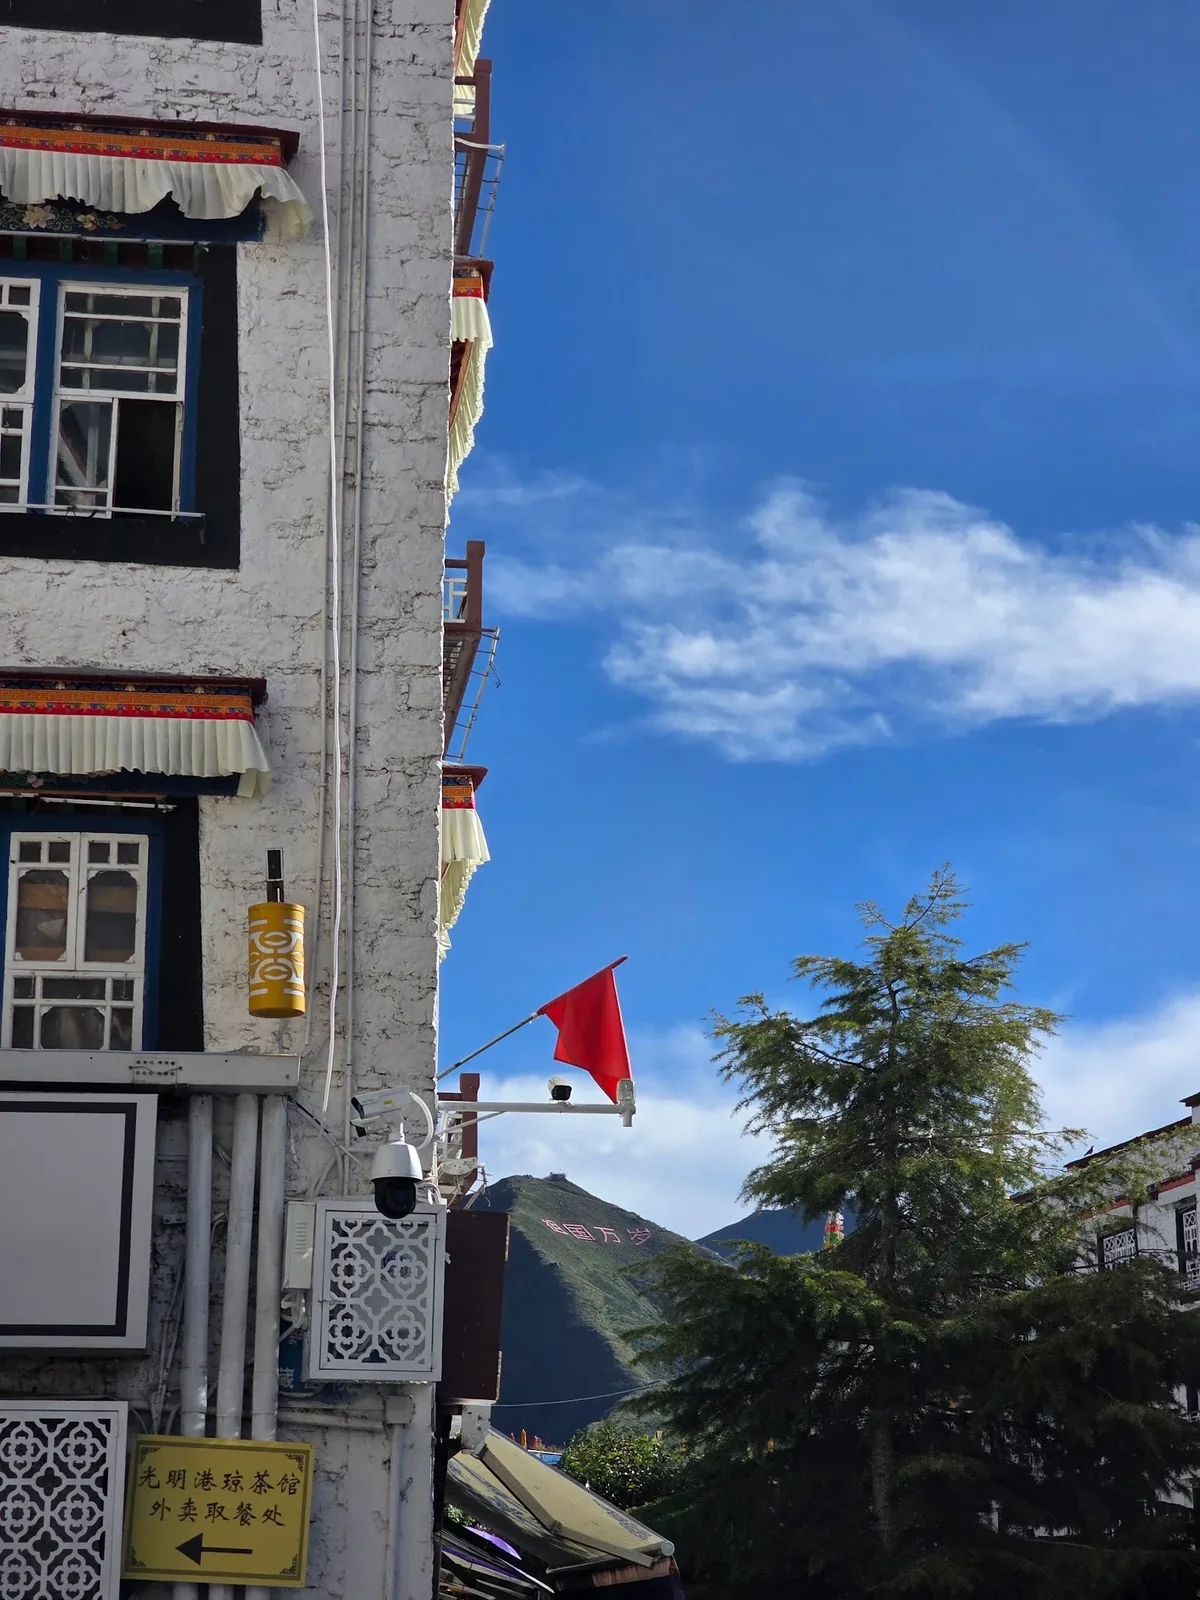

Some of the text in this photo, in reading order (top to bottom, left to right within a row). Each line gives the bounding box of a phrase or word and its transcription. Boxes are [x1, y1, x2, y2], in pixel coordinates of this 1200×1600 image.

[541, 1218, 652, 1245] 祖国万岁
[138, 1465, 301, 1496] 光明港琼茶馆
[149, 1497, 286, 1527] 外卖取餐处
